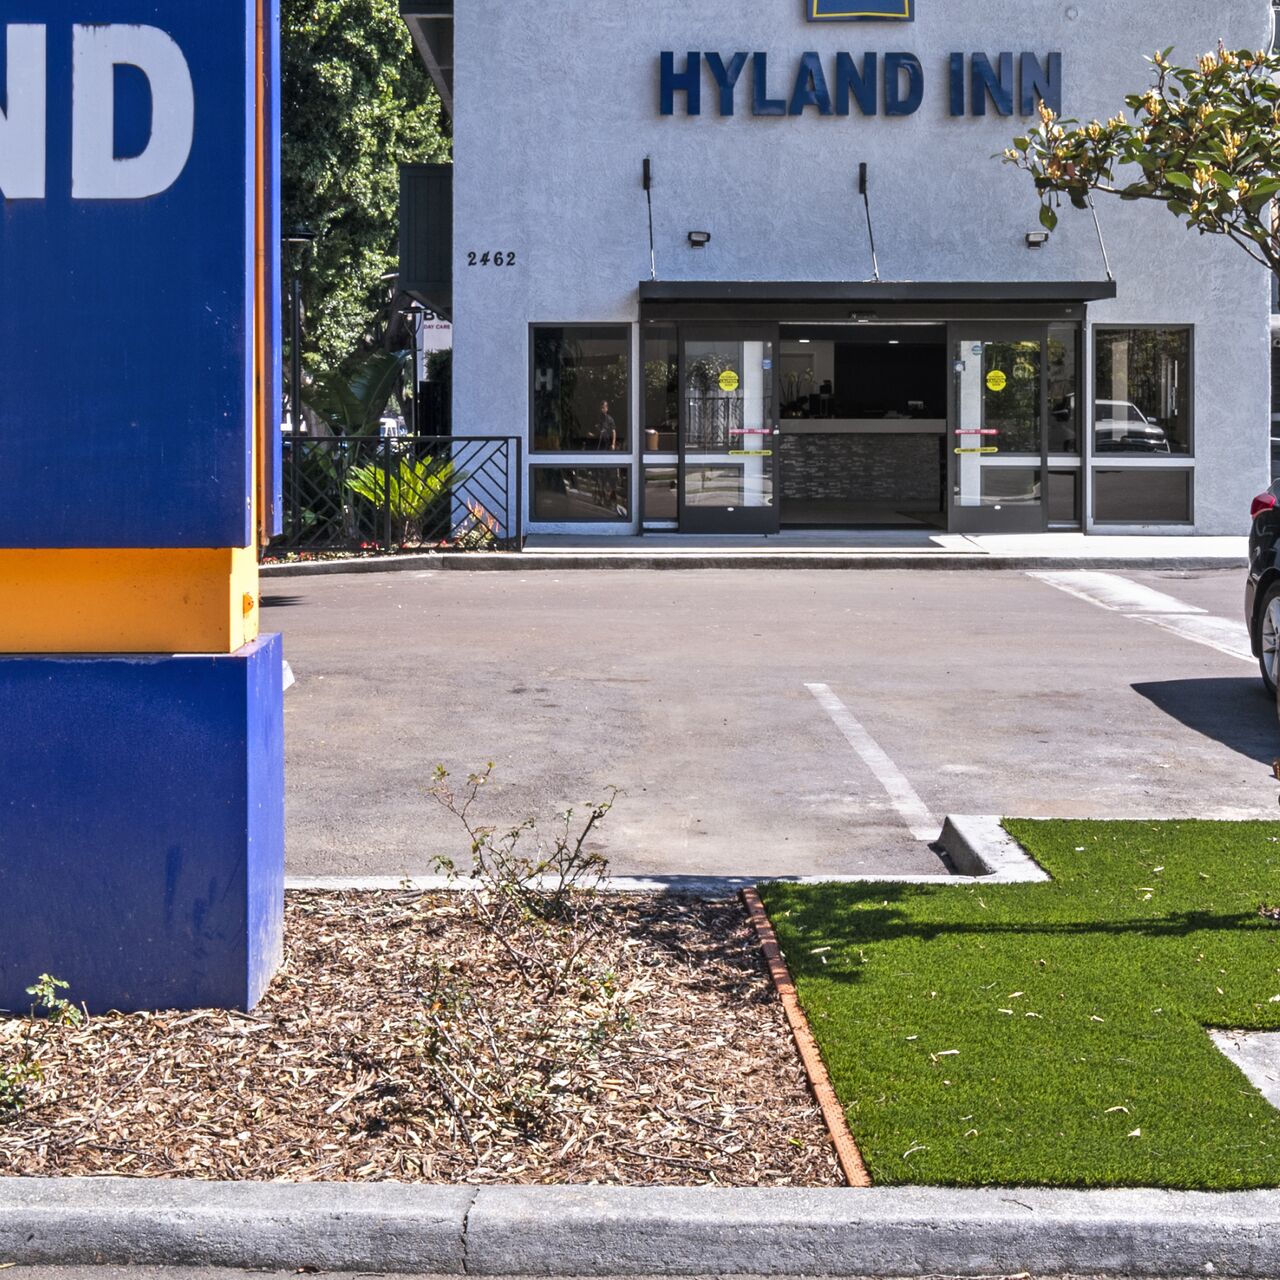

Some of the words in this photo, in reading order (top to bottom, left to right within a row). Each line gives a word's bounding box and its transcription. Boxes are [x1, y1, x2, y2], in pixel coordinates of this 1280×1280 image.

[658, 51, 924, 116] HYLAND
[949, 51, 1062, 117] INN
[467, 251, 516, 266] 2462
